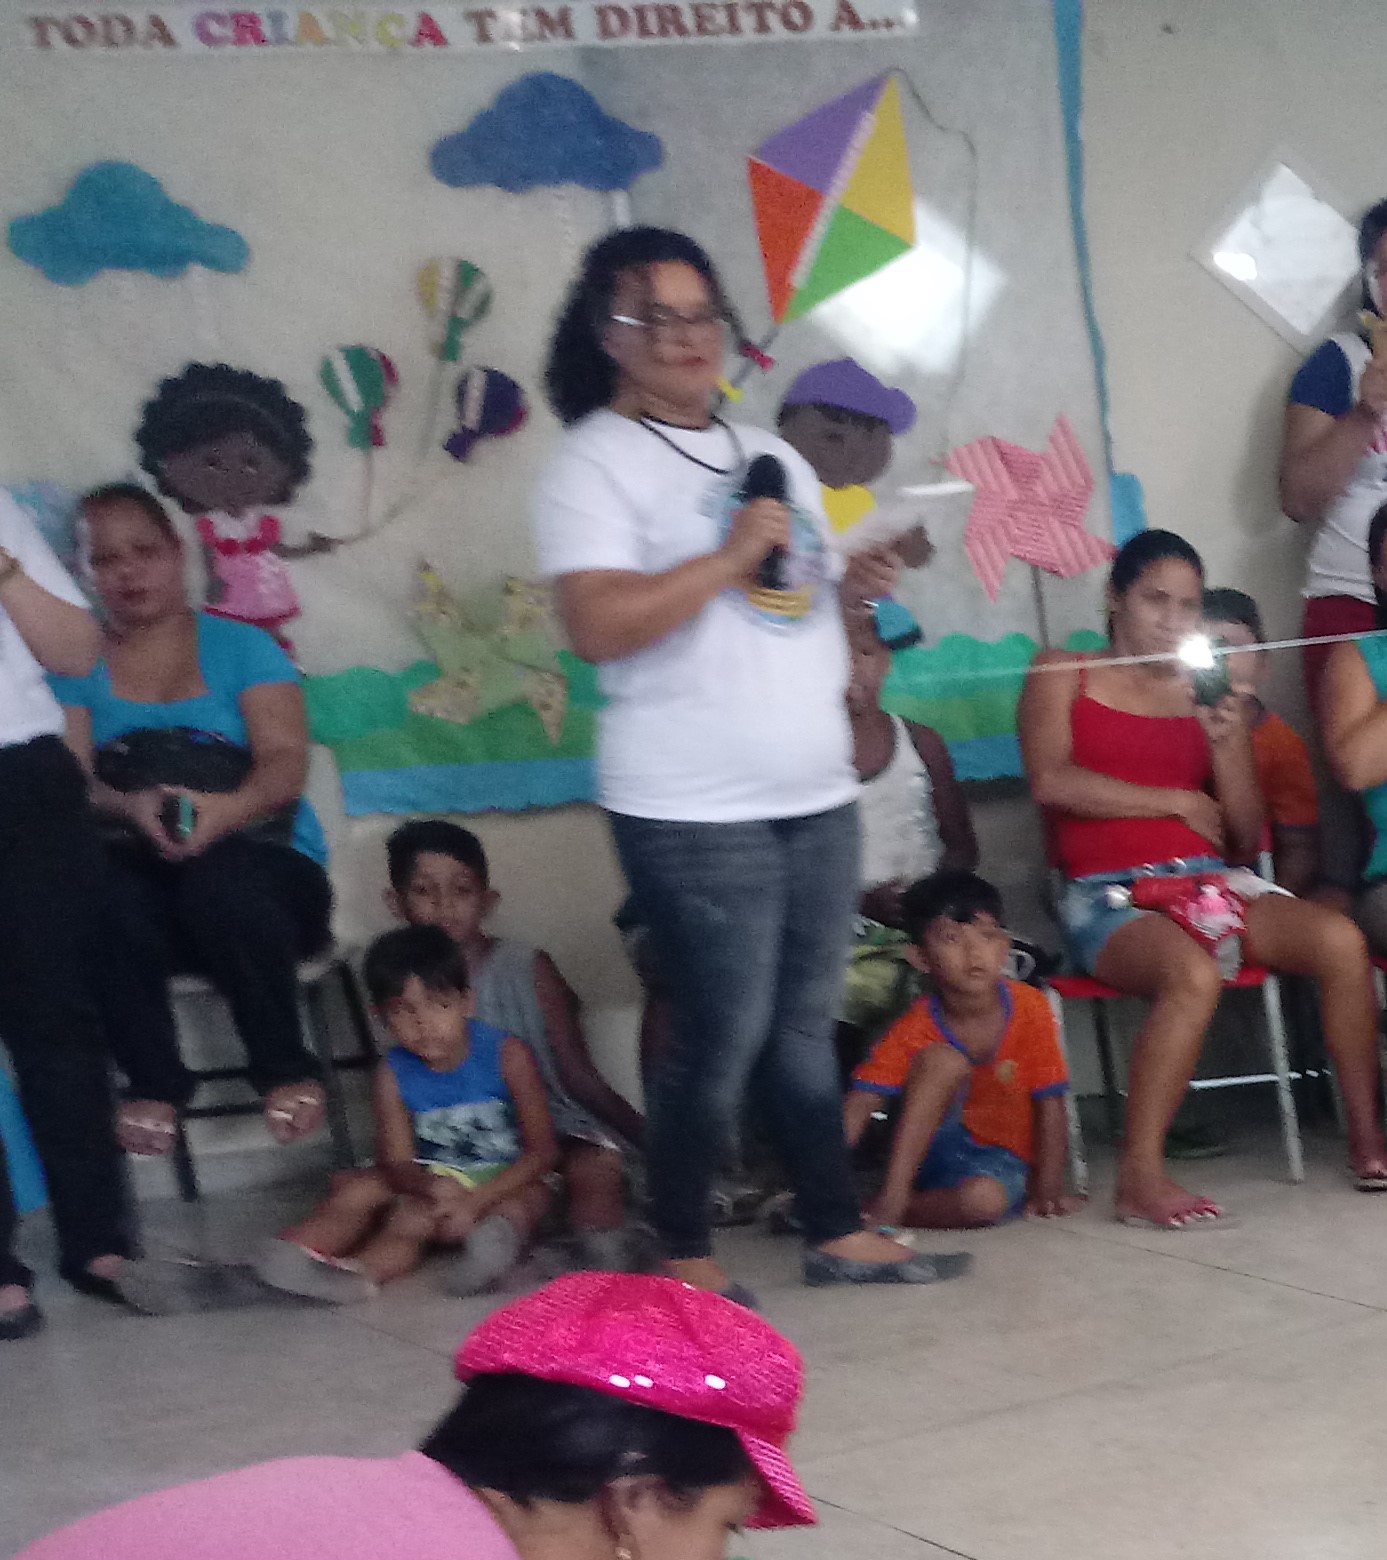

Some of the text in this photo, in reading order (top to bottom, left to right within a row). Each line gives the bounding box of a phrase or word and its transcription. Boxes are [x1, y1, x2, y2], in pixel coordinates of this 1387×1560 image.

[27, 13, 181, 49] TODA
[194, 9, 449, 52] CRIANÇA
[596, 0, 814, 39] DIREITO
